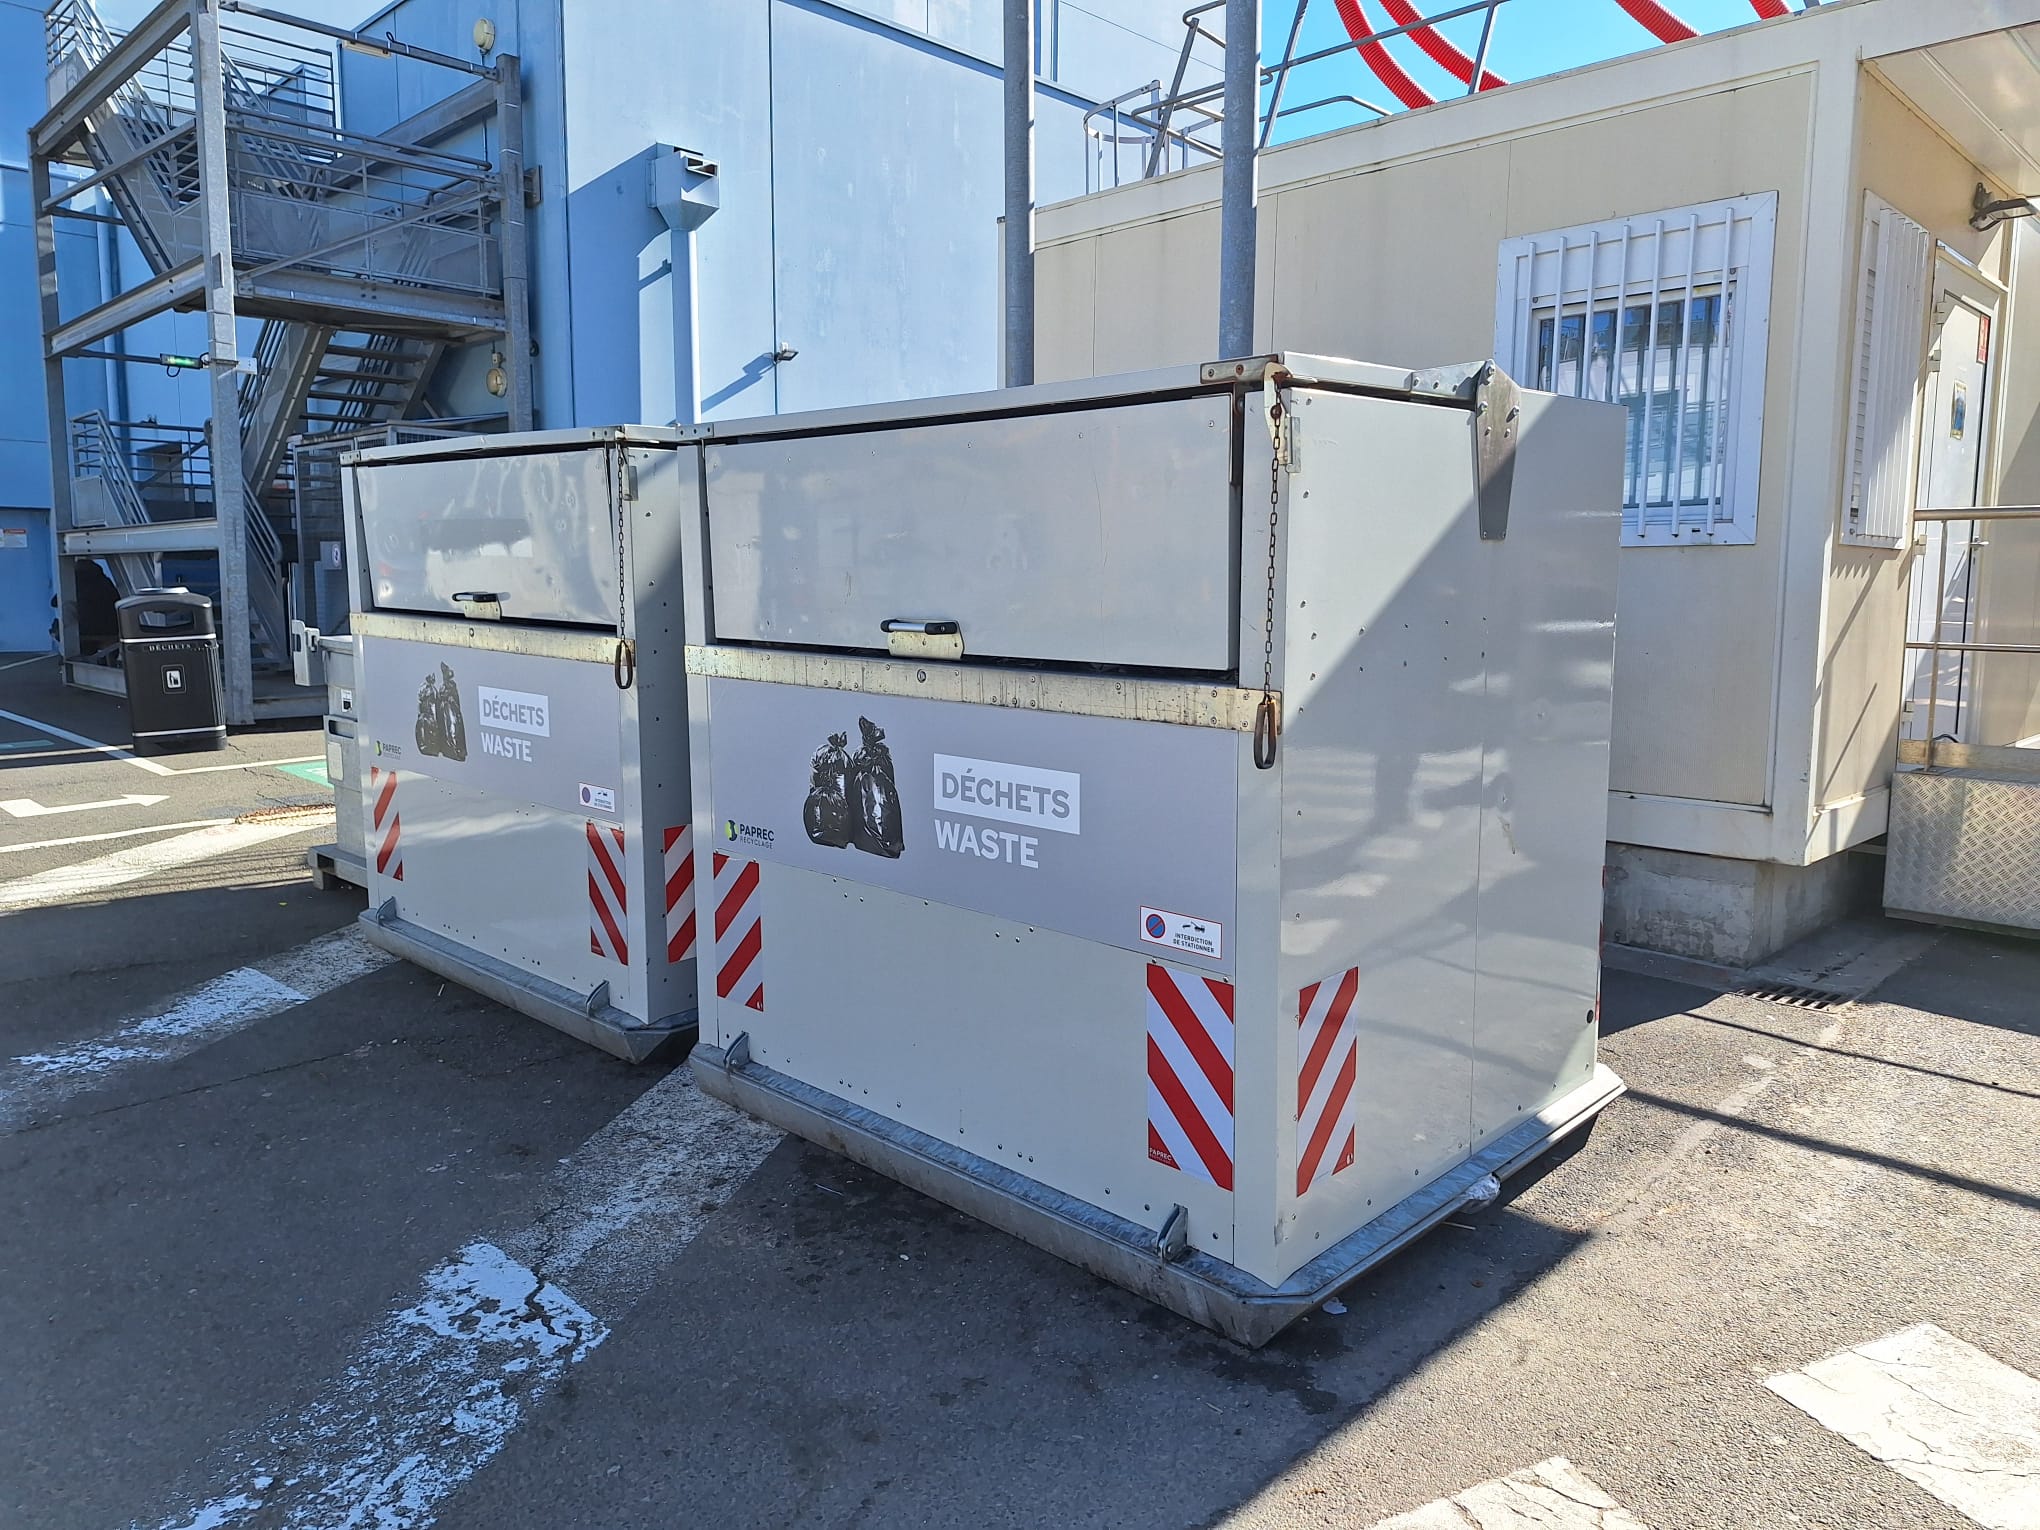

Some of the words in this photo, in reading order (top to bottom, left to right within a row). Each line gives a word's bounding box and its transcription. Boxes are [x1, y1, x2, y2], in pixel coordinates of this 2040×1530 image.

[482, 694, 545, 728] DÉCHETS
[480, 732, 533, 762] WASTE
[942, 768, 1070, 818] DÉCHETS
[740, 823, 775, 842] PAPREC
[739, 835, 774, 850] RECYCLAGE
[934, 819, 1039, 869] WASTE
[1173, 938, 1180, 946] DE
[1181, 940, 1215, 954] STATIONNER
[1174, 932, 1213, 947] INTERDICTION
[1149, 1147, 1173, 1161] PAPREC
